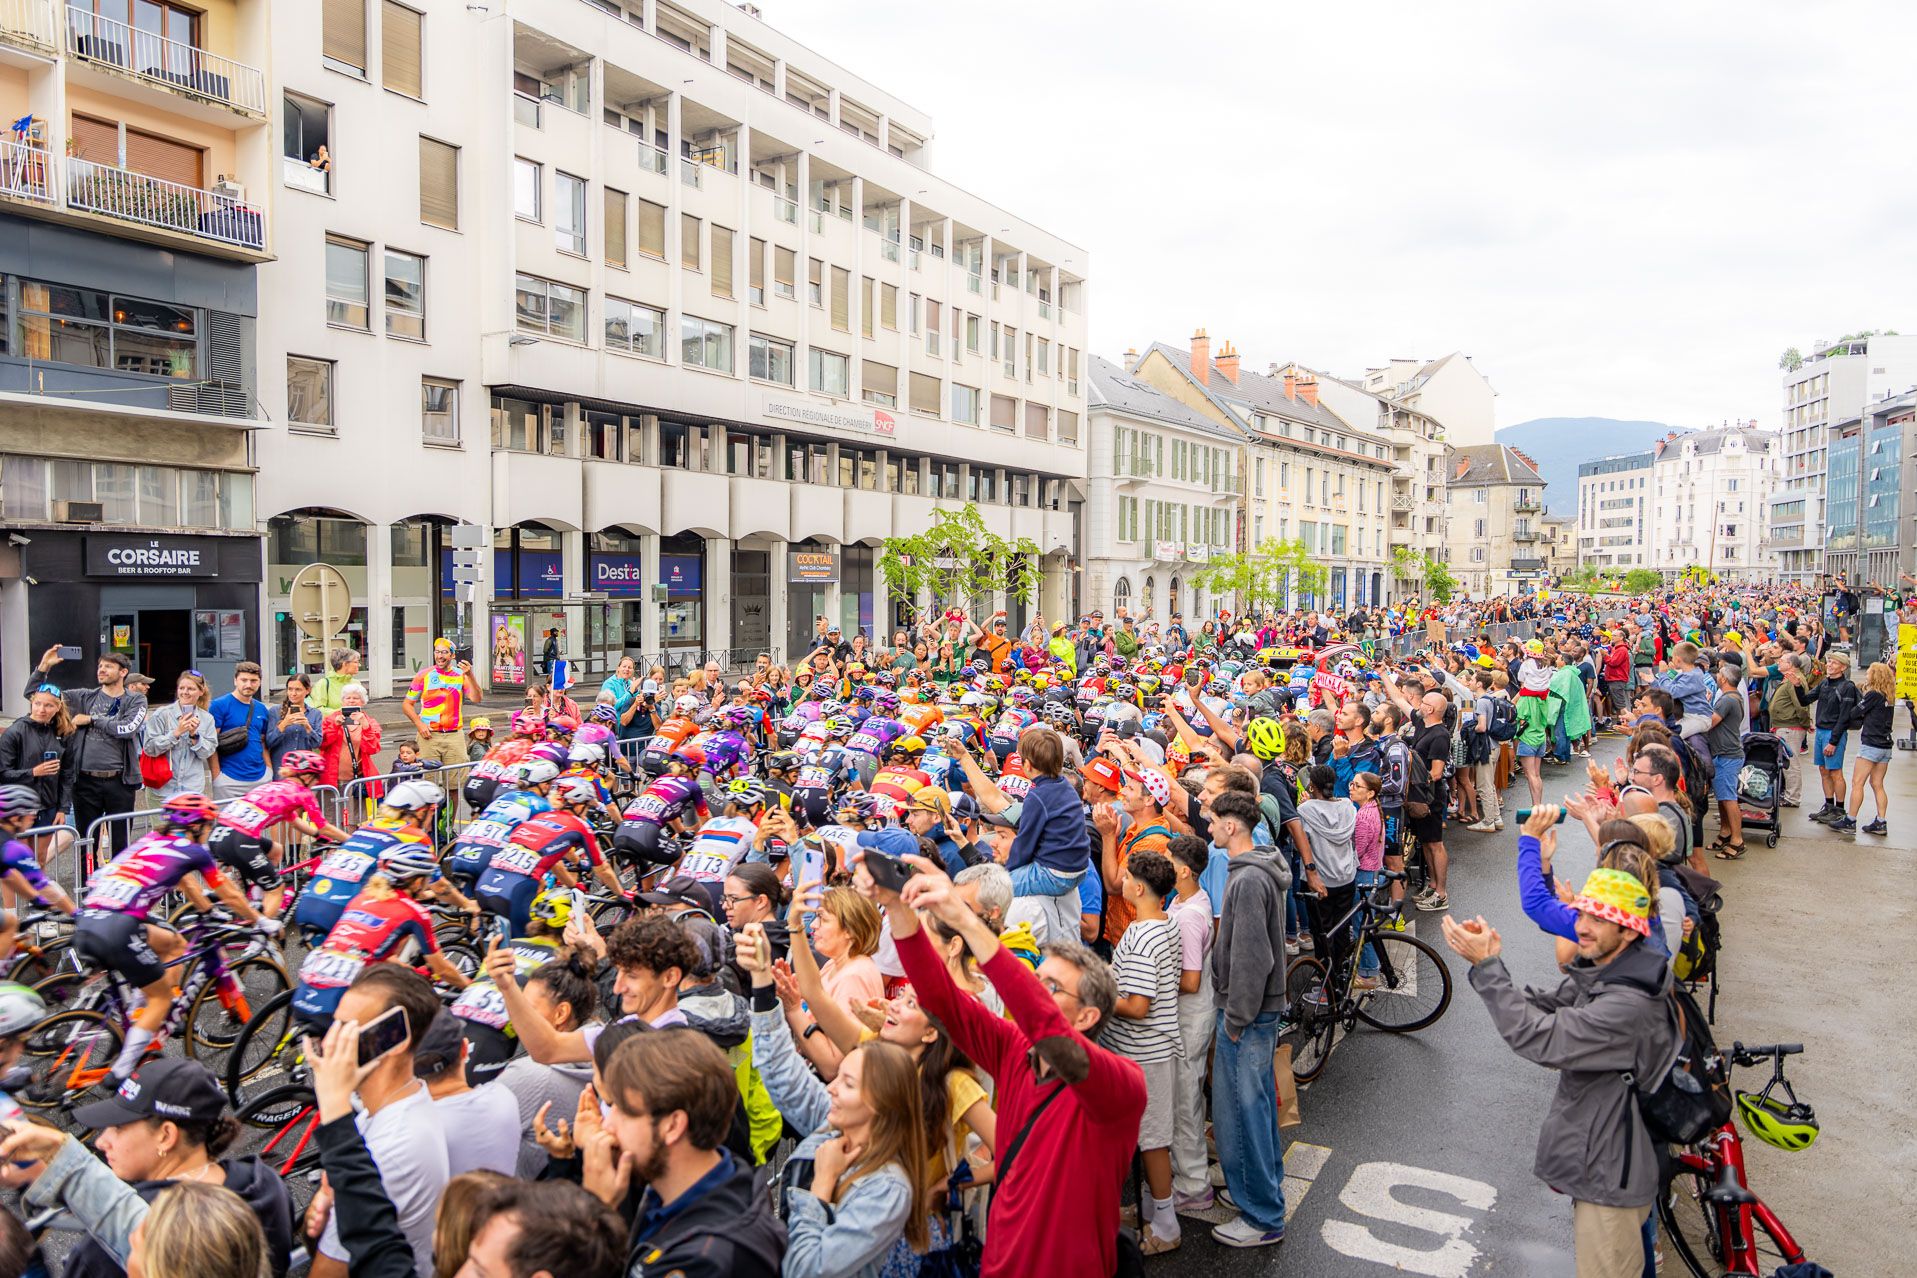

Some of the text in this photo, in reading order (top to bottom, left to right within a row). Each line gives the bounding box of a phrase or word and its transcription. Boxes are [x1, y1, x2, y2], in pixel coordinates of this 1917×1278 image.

[769, 403, 801, 417] DIRECTION
[835, 415, 843, 425] DE
[875, 419, 895, 433] SNCF
[150, 540, 159, 548] LE
[107, 548, 200, 566] CORSAIRE
[797, 554, 833, 565] COCKTAIL
[598, 563, 640, 580] Destia
[656, 737, 670, 748] 23
[810, 770, 822, 780] 74
[467, 778, 484, 790] EF
[1012, 776, 1029, 791] 113
[643, 797, 661, 814] 166
[208, 826, 235, 842] EF
[482, 824, 501, 840] 97
[506, 848, 534, 870] 215
[703, 856, 723, 874] 73
